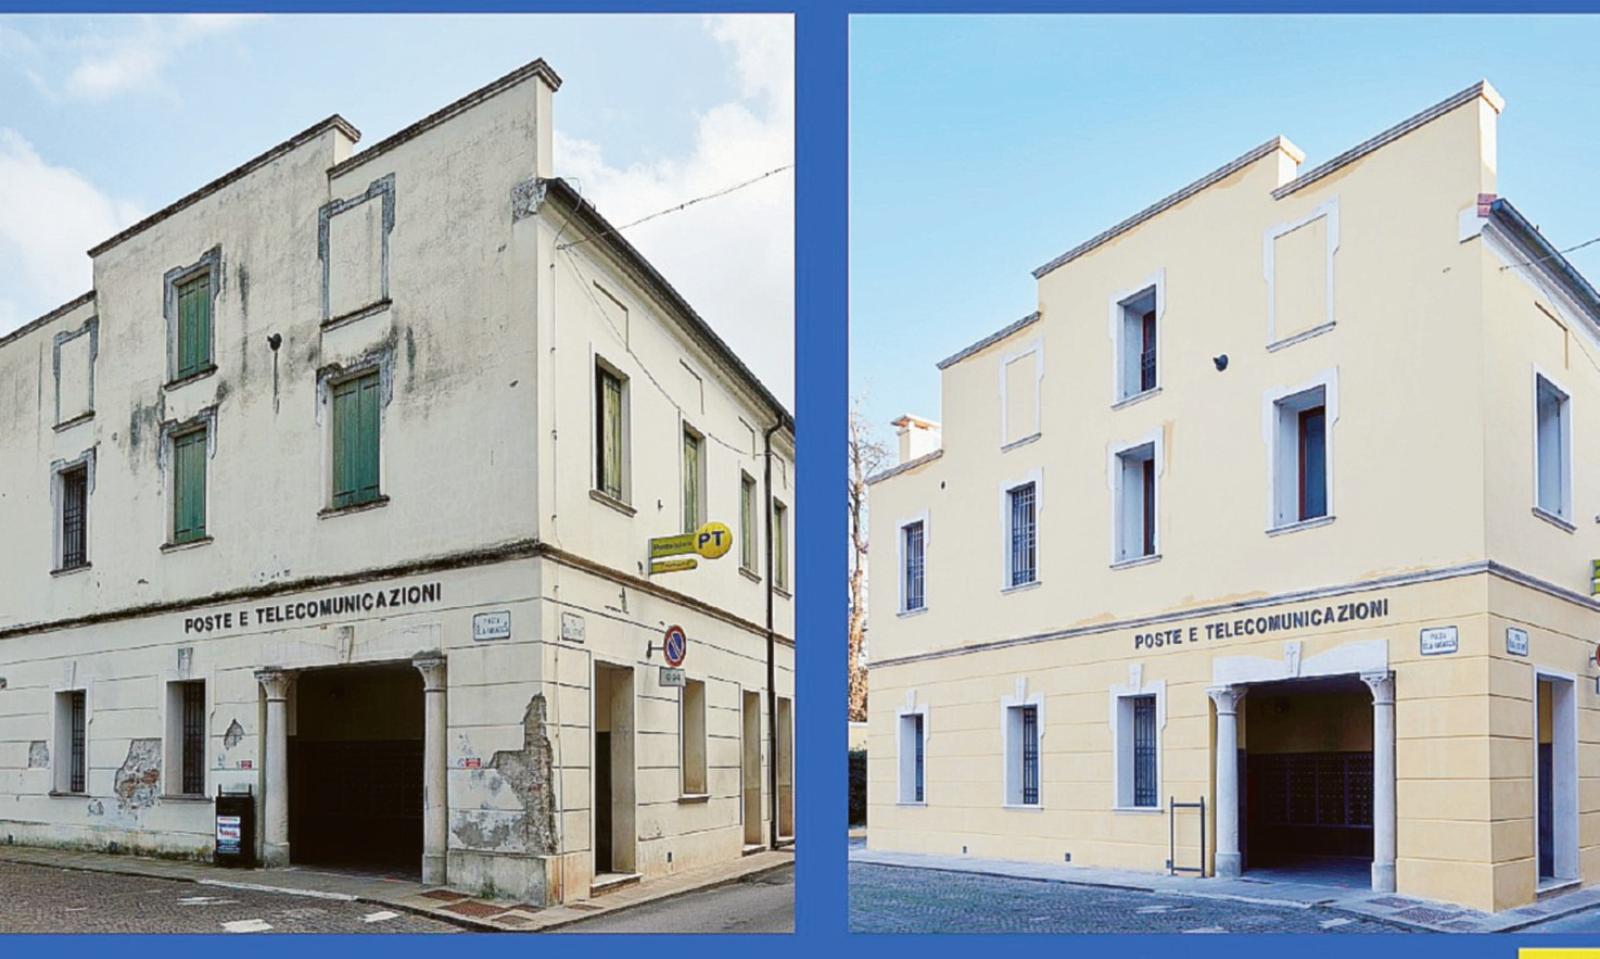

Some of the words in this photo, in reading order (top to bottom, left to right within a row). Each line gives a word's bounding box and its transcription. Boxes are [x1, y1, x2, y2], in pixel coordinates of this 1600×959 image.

[698, 530, 725, 549] PT
[185, 612, 232, 634] POSTE
[239, 611, 248, 626] E
[256, 582, 442, 624] TELECOMUNICAZIONI
[1135, 628, 1183, 649] POSTE
[1189, 626, 1198, 642] E
[1205, 598, 1389, 640] TELECOMUNICAZIONI
